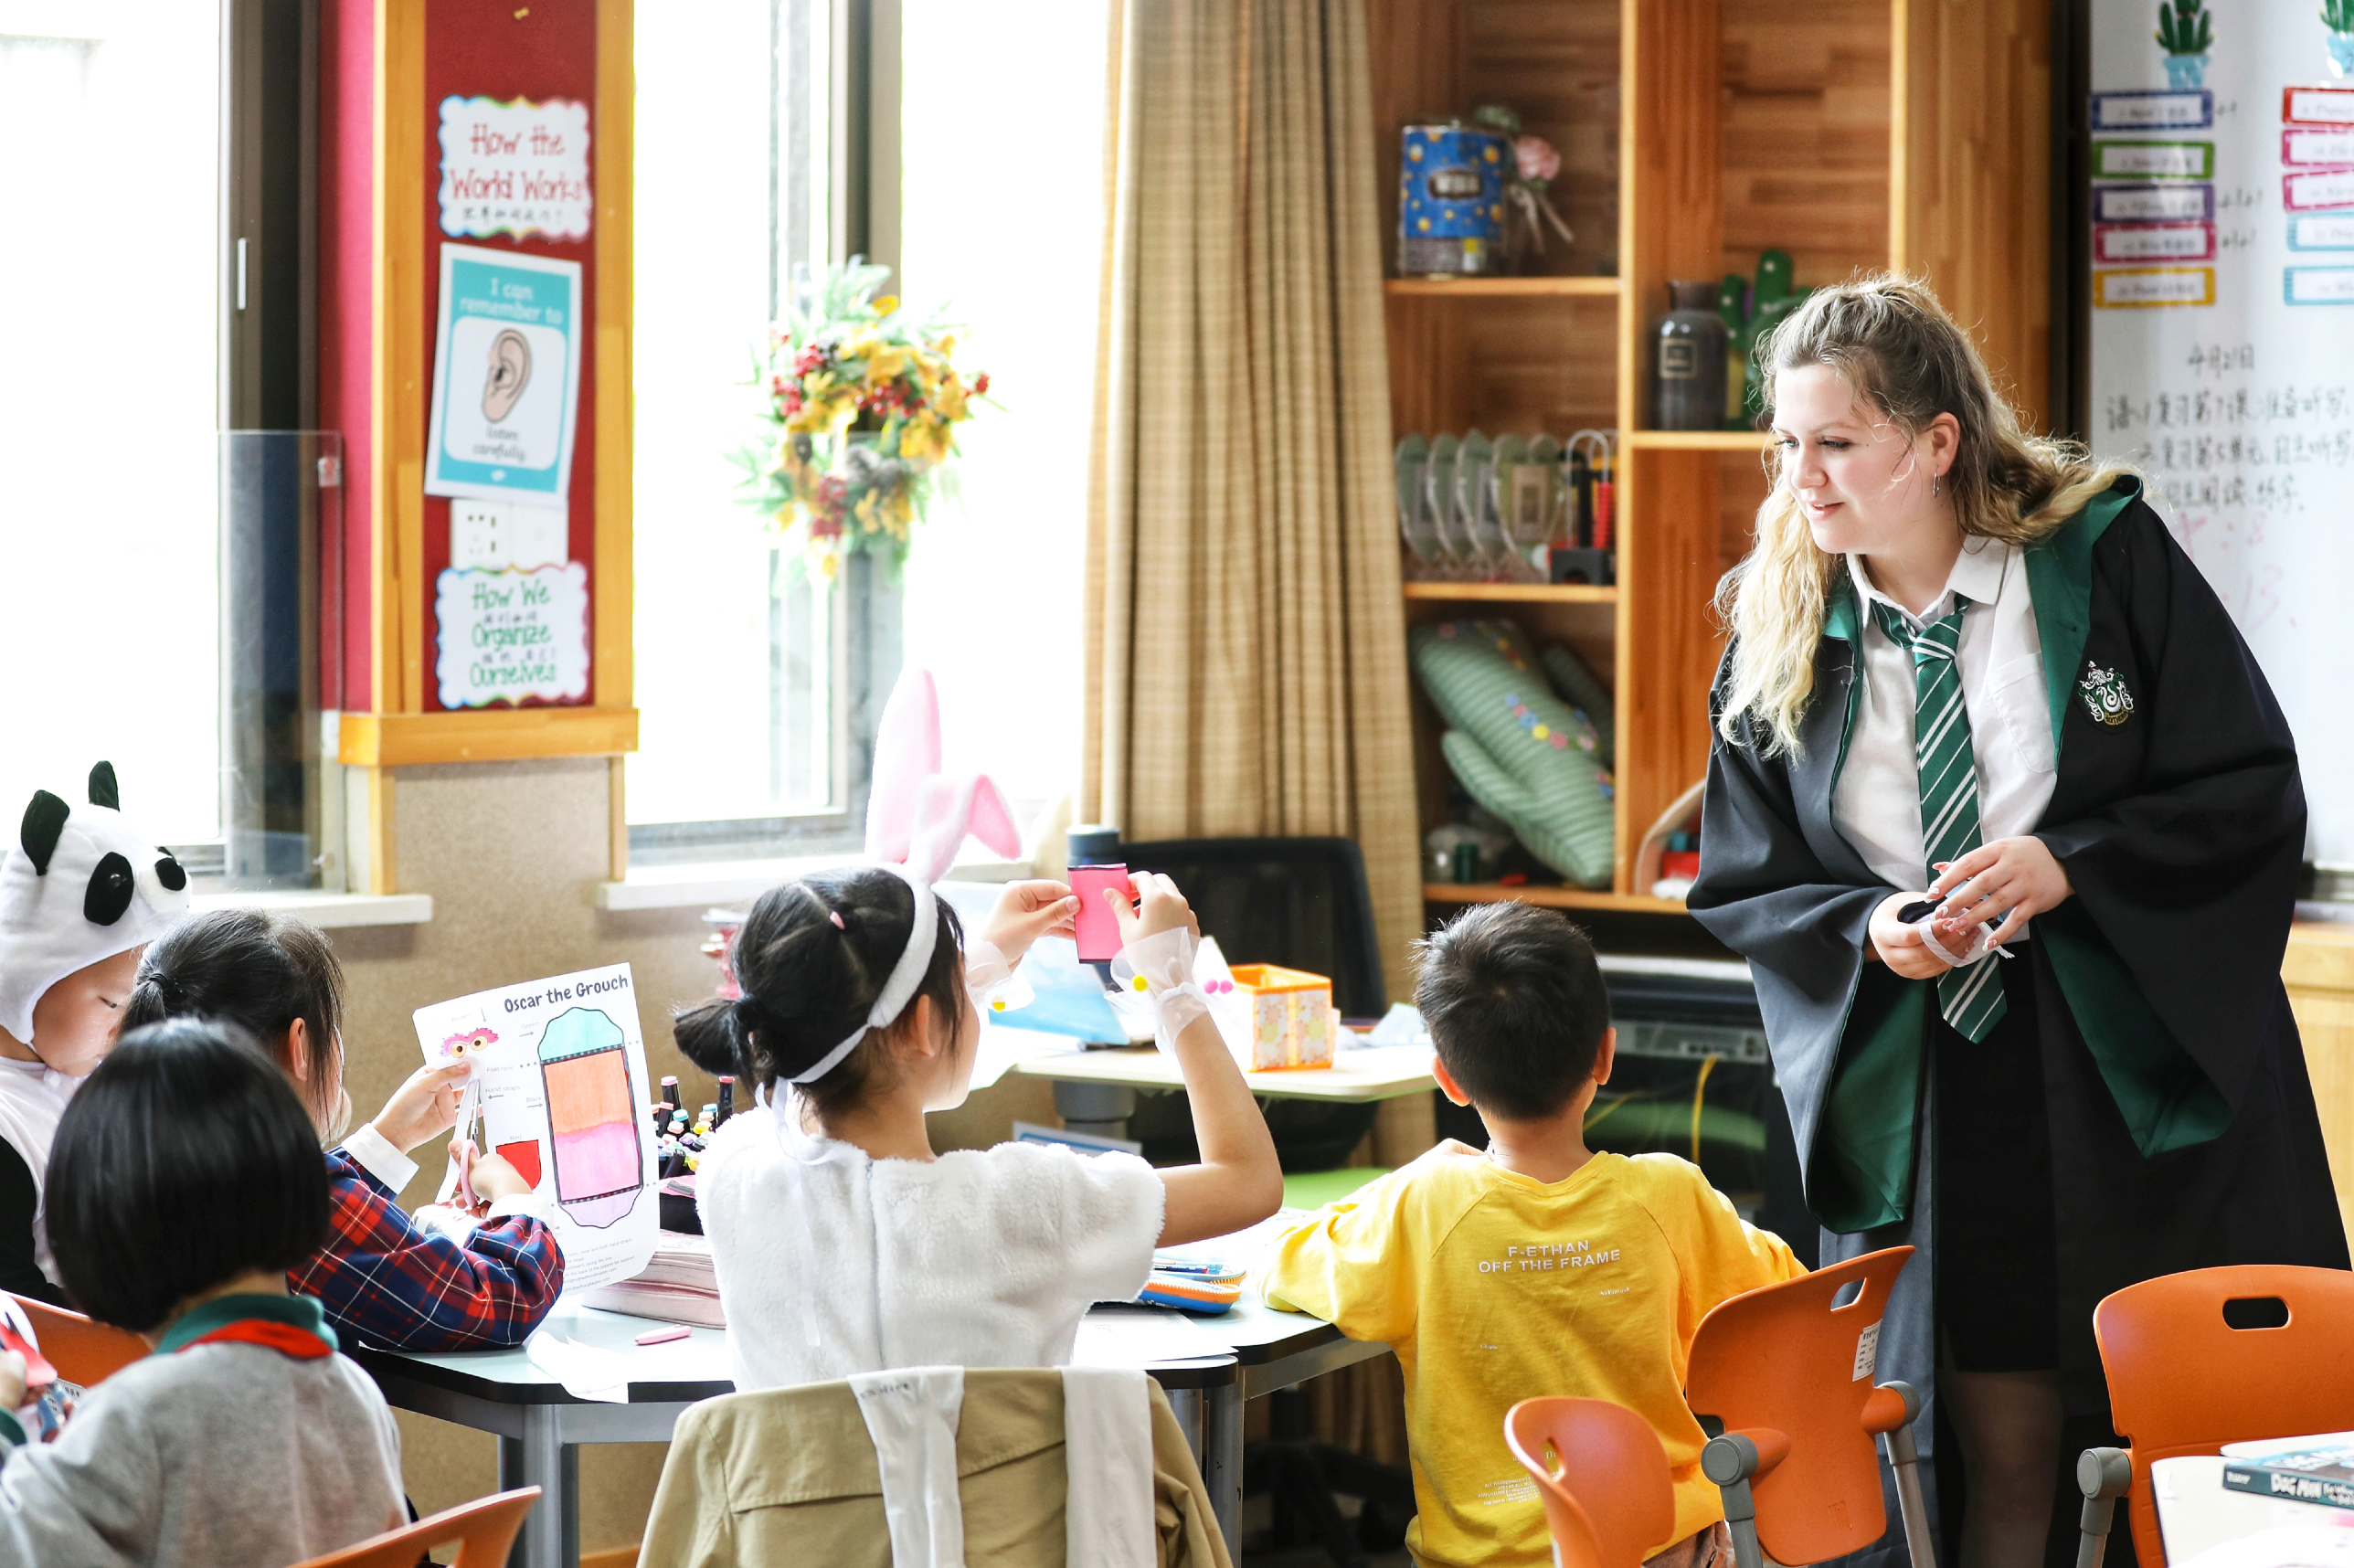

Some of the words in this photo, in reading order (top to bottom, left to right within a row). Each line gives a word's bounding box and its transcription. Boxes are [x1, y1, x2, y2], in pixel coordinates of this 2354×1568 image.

[470, 122, 522, 155] How
[529, 125, 566, 155] the
[449, 167, 514, 200] World
[521, 169, 586, 202] Works
[503, 281, 533, 301] can
[460, 297, 542, 320] remember
[546, 306, 563, 324] to
[472, 582, 514, 610] How
[520, 578, 551, 607] We
[472, 622, 552, 652] Organize
[470, 660, 557, 688] Ourselves
[504, 993, 543, 1013] Oscar
[546, 988, 572, 1004] the
[576, 974, 629, 998] Grouch
[451, 1013, 470, 1022] Brown
[522, 1021, 539, 1030] Green
[1478, 1261, 1512, 1273] OFF
[1519, 1259, 1553, 1271] THE
[1560, 1249, 1621, 1269] FRAME
[1508, 1240, 1589, 1257] F-ETHAN
[2271, 1472, 2297, 1496] DOG
